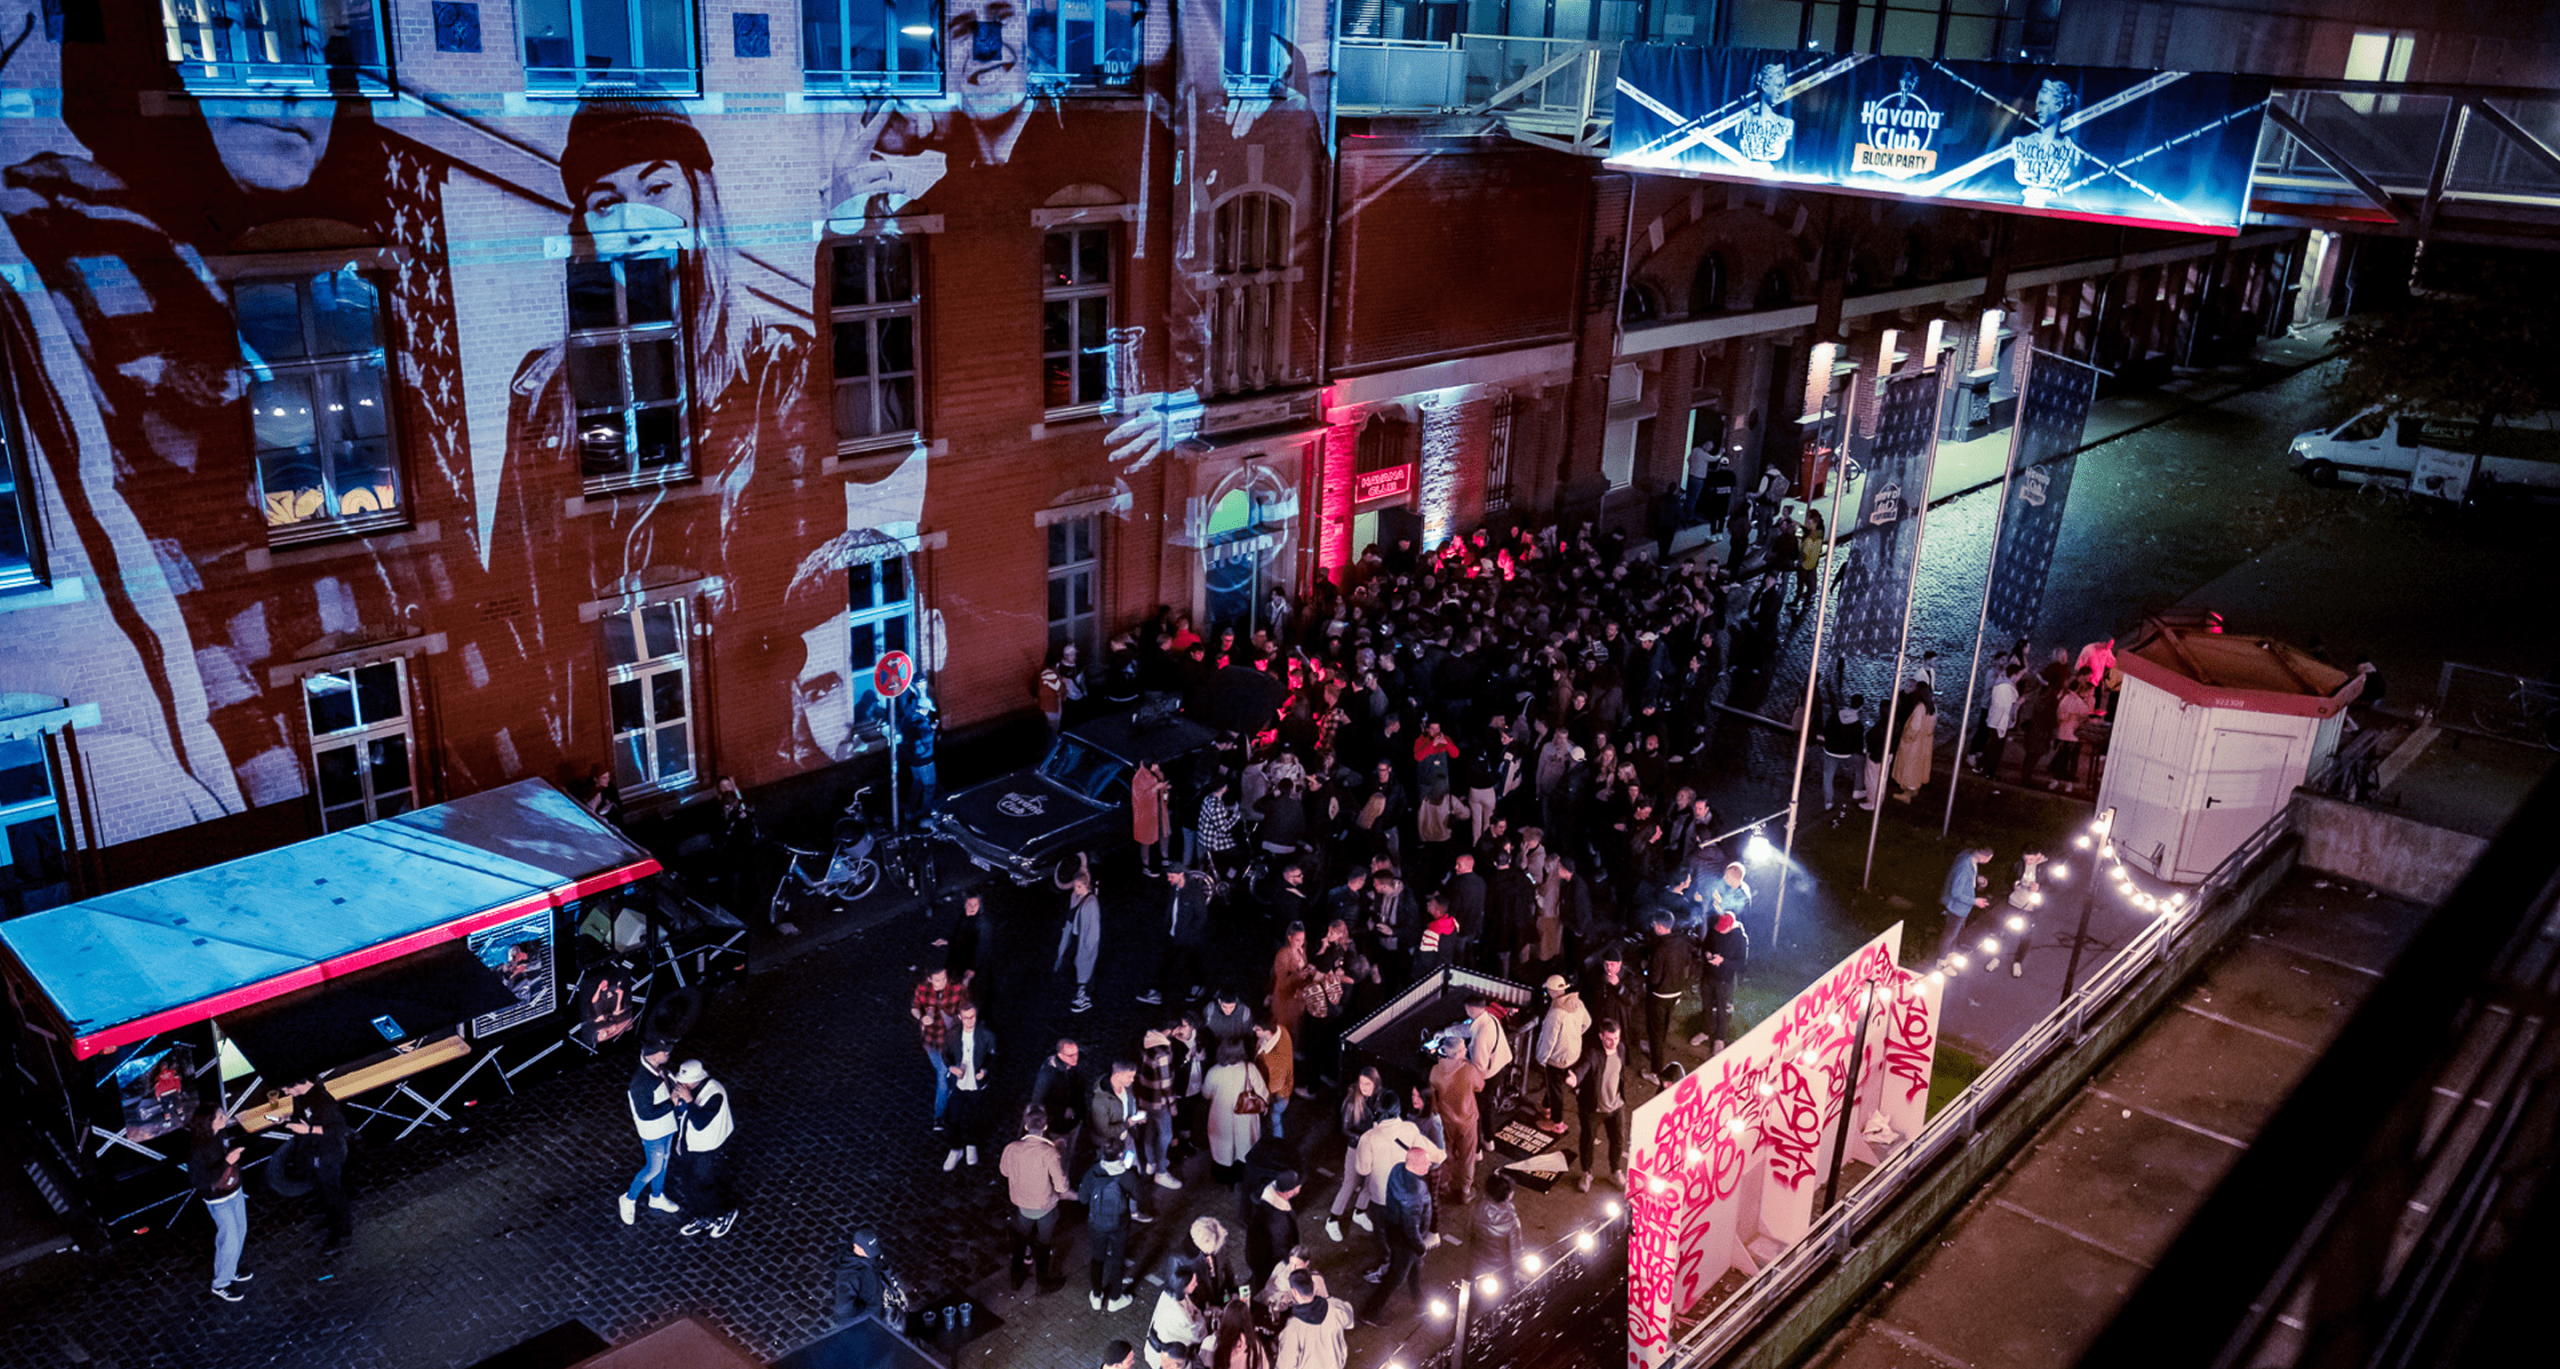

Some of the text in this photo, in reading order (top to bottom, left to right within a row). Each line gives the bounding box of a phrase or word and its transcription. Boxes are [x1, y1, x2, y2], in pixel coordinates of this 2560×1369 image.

[1861, 101, 1941, 129] Havana
[1875, 127, 1920, 150] Club
[1862, 151, 1928, 169] BLOCK PARTY
[1361, 470, 1404, 488] HAVANA
[1368, 481, 1397, 496] CLUB
[1001, 801, 1025, 815] Club
[1004, 792, 1044, 815] Havana
[1519, 1139, 1541, 1154] LIKE
